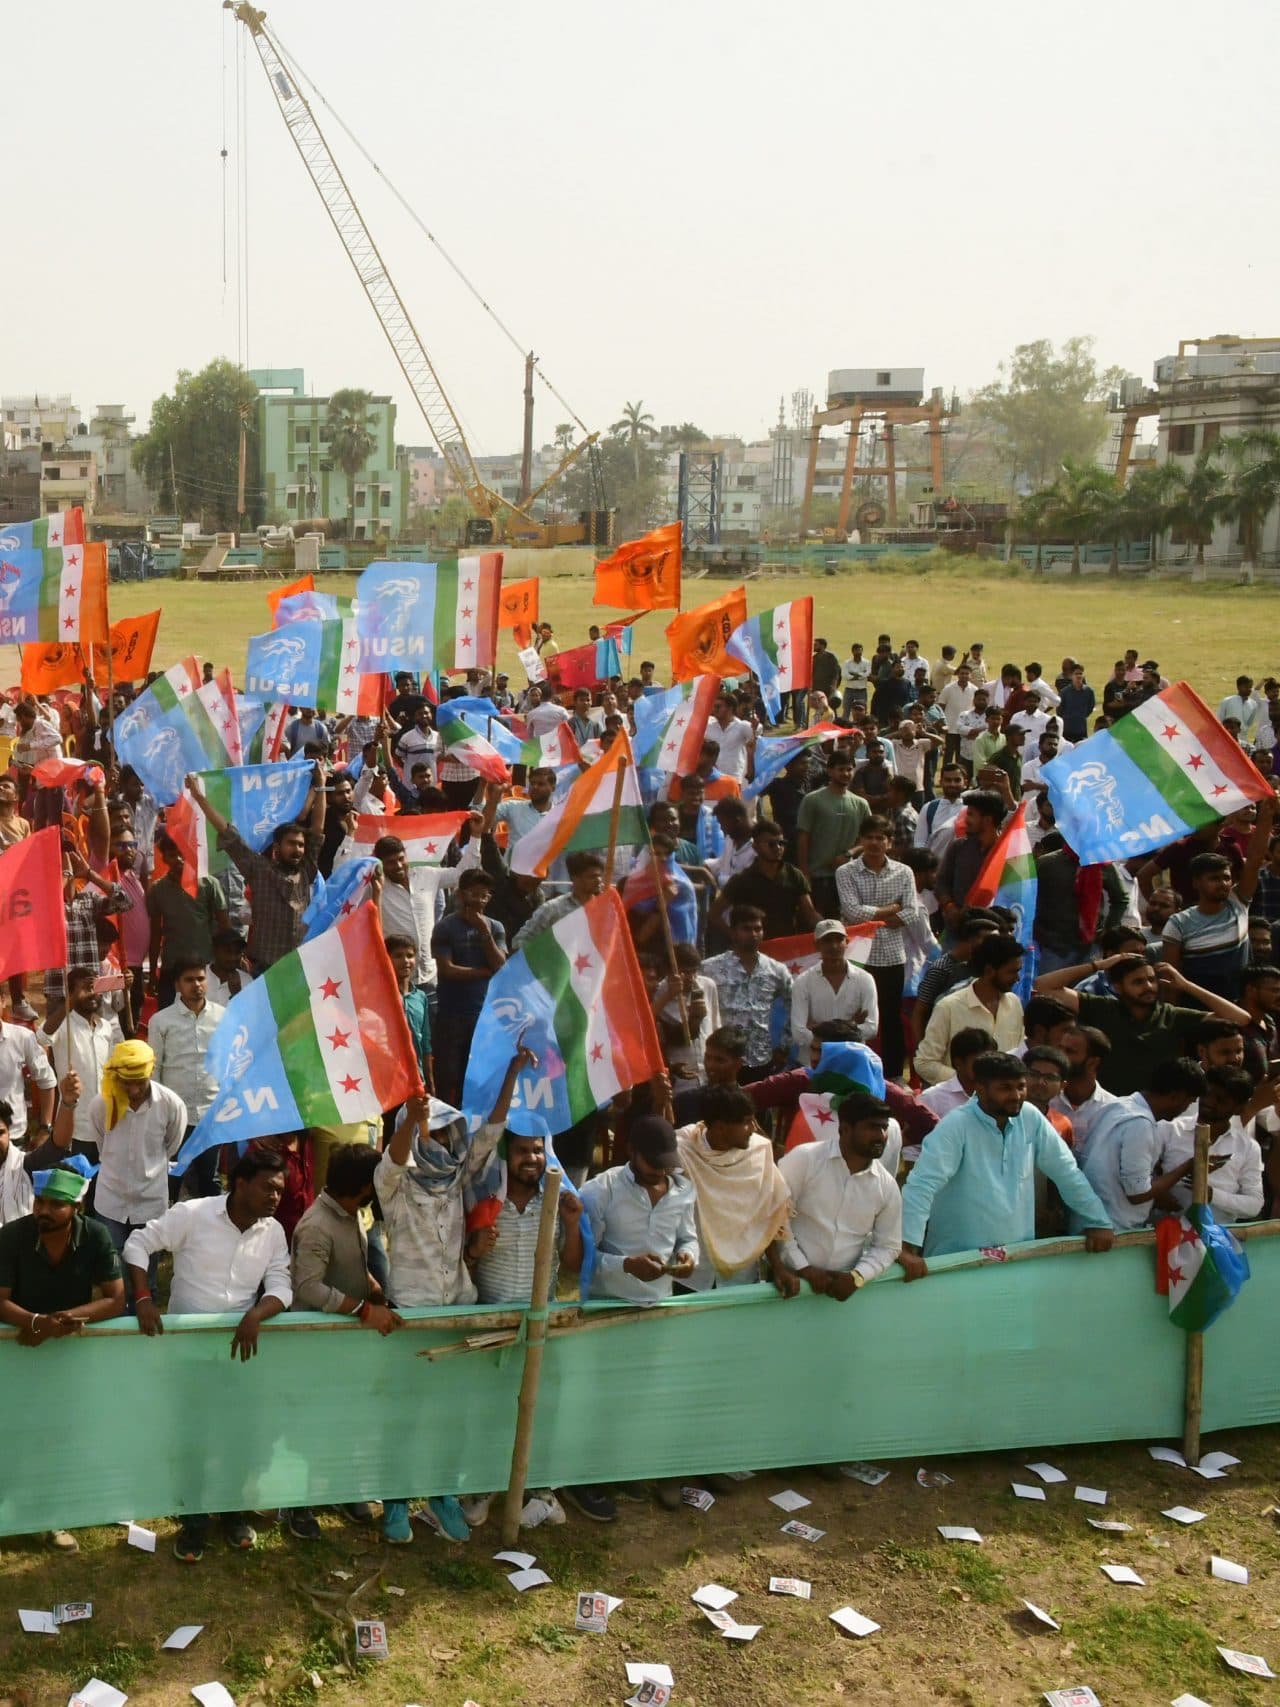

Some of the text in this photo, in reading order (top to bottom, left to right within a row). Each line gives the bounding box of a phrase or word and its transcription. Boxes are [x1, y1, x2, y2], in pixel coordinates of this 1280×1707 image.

[722, 613, 731, 642] ABV
[594, 1599, 606, 1616] 5
[371, 1627, 382, 1643] 5
[654, 1689, 665, 1704] 5
